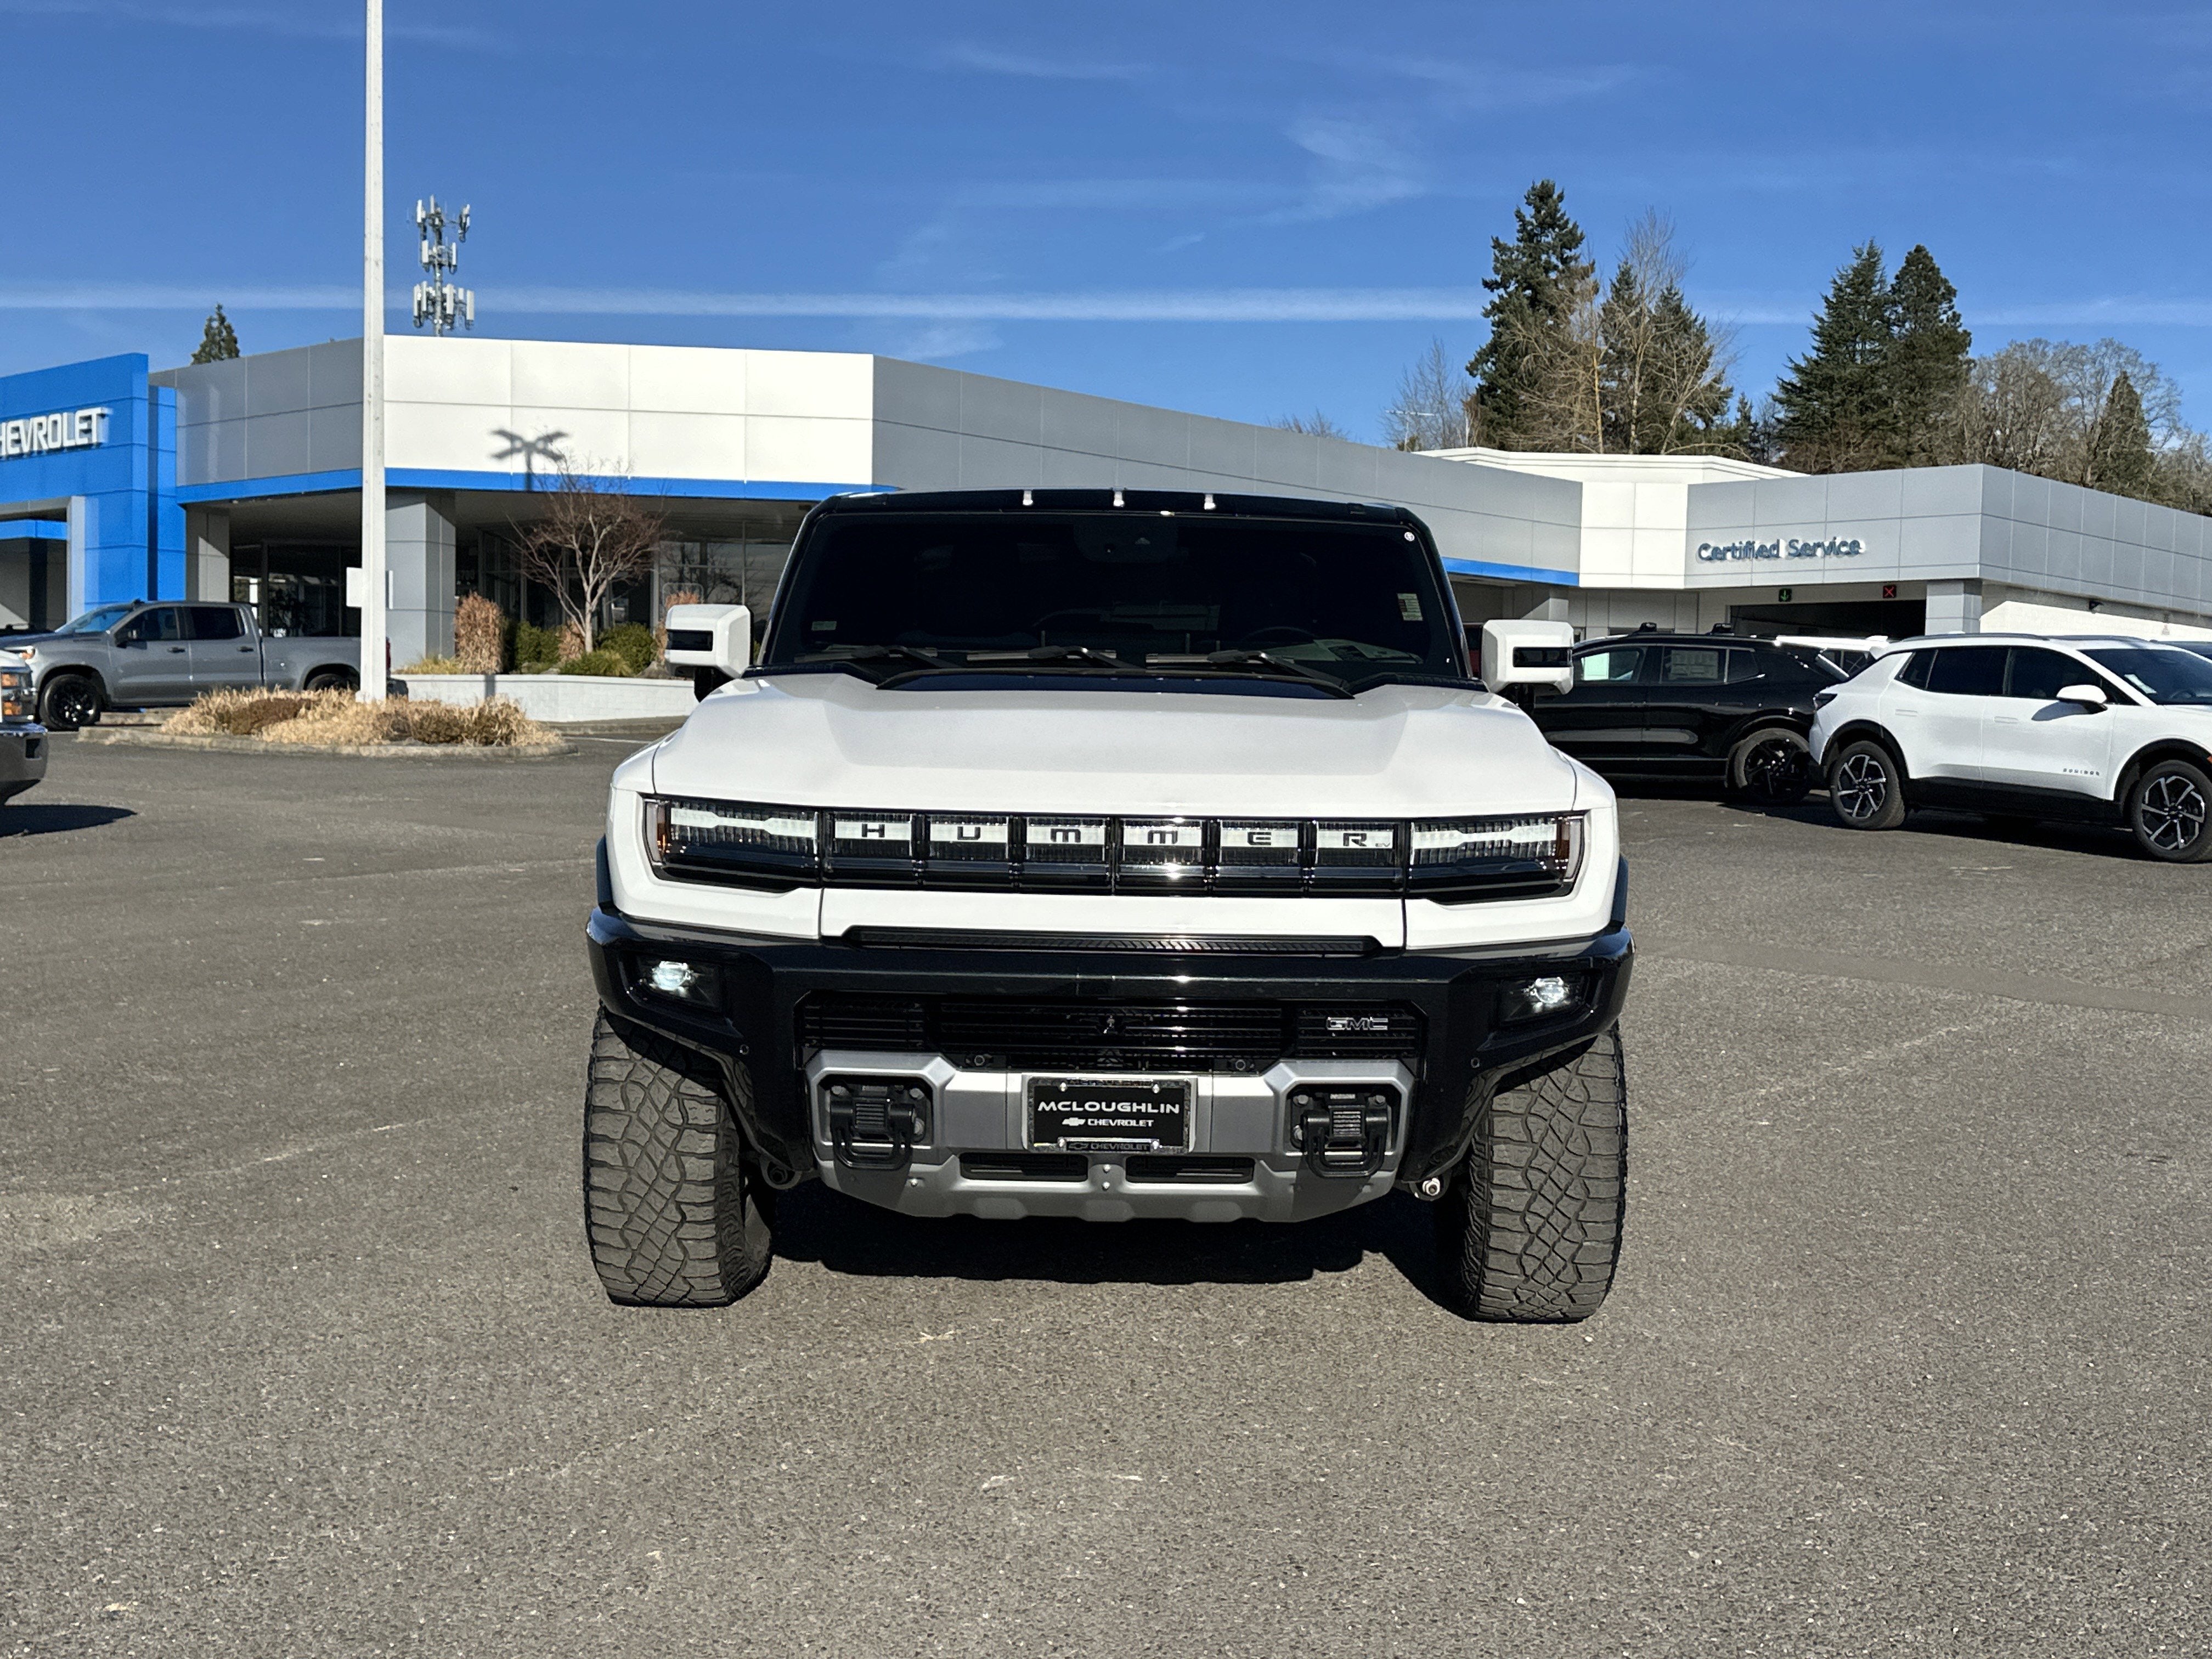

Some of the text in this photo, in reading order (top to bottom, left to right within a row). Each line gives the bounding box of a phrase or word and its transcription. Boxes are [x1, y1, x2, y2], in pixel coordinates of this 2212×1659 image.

[0, 407, 104, 456] HEVROLET
[1698, 537, 1862, 561] Certified Service
[861, 823, 1367, 847] HUMMER
[1326, 1017, 1389, 1031] GMC
[1037, 1101, 1180, 1114] MCLOUGHLIN
[1087, 1118, 1154, 1127] CHEVROLET
[1091, 1143, 1150, 1152] CHEVROLET
